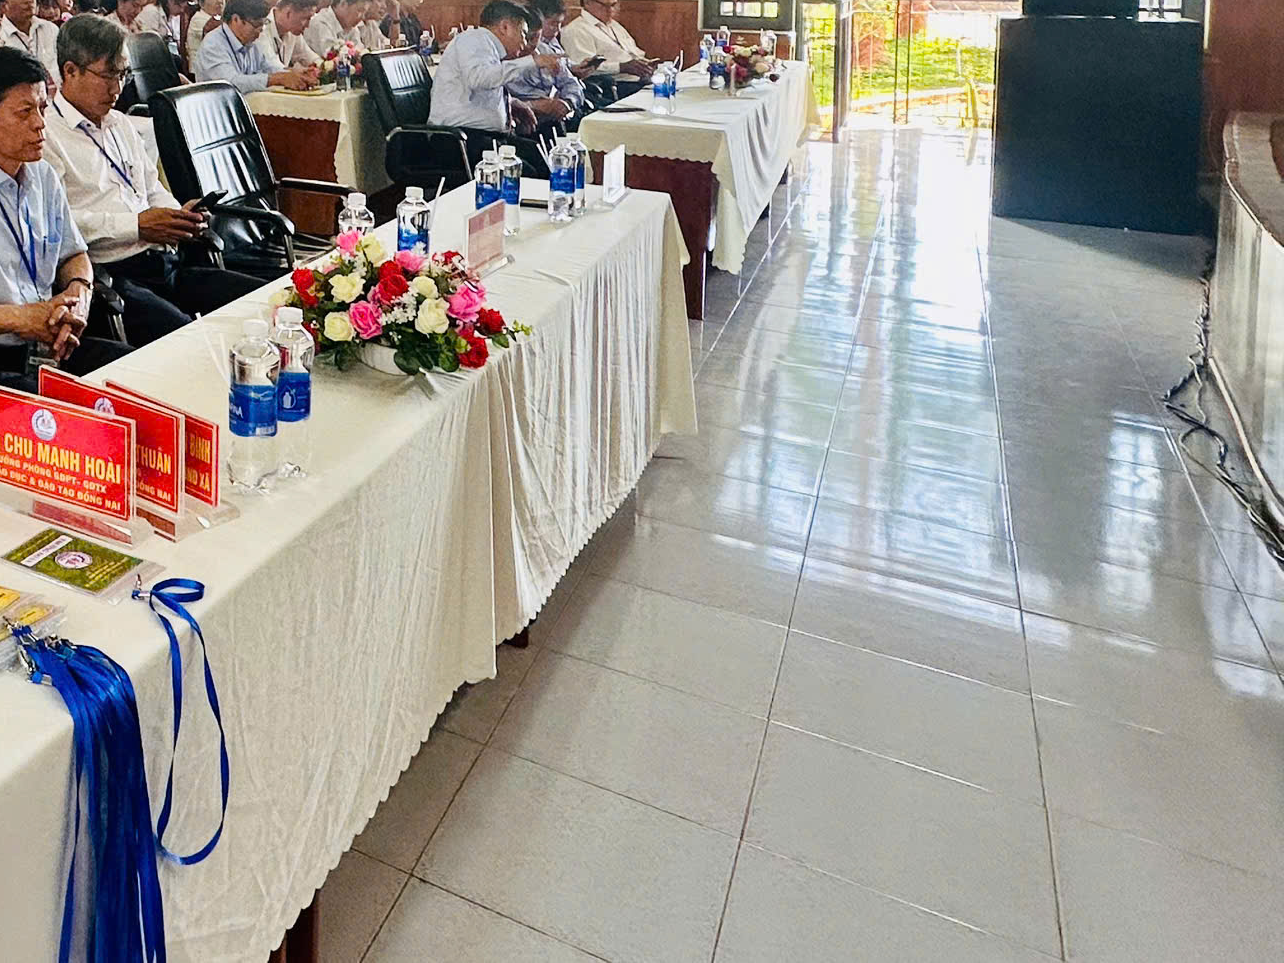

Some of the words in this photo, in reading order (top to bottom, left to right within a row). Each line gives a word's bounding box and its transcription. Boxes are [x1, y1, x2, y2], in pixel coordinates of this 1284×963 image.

[4, 433, 33, 458] CHU
[37, 442, 80, 472] MẠNH
[85, 455, 121, 484] HOÀI
[104, 498, 121, 511] NAI
